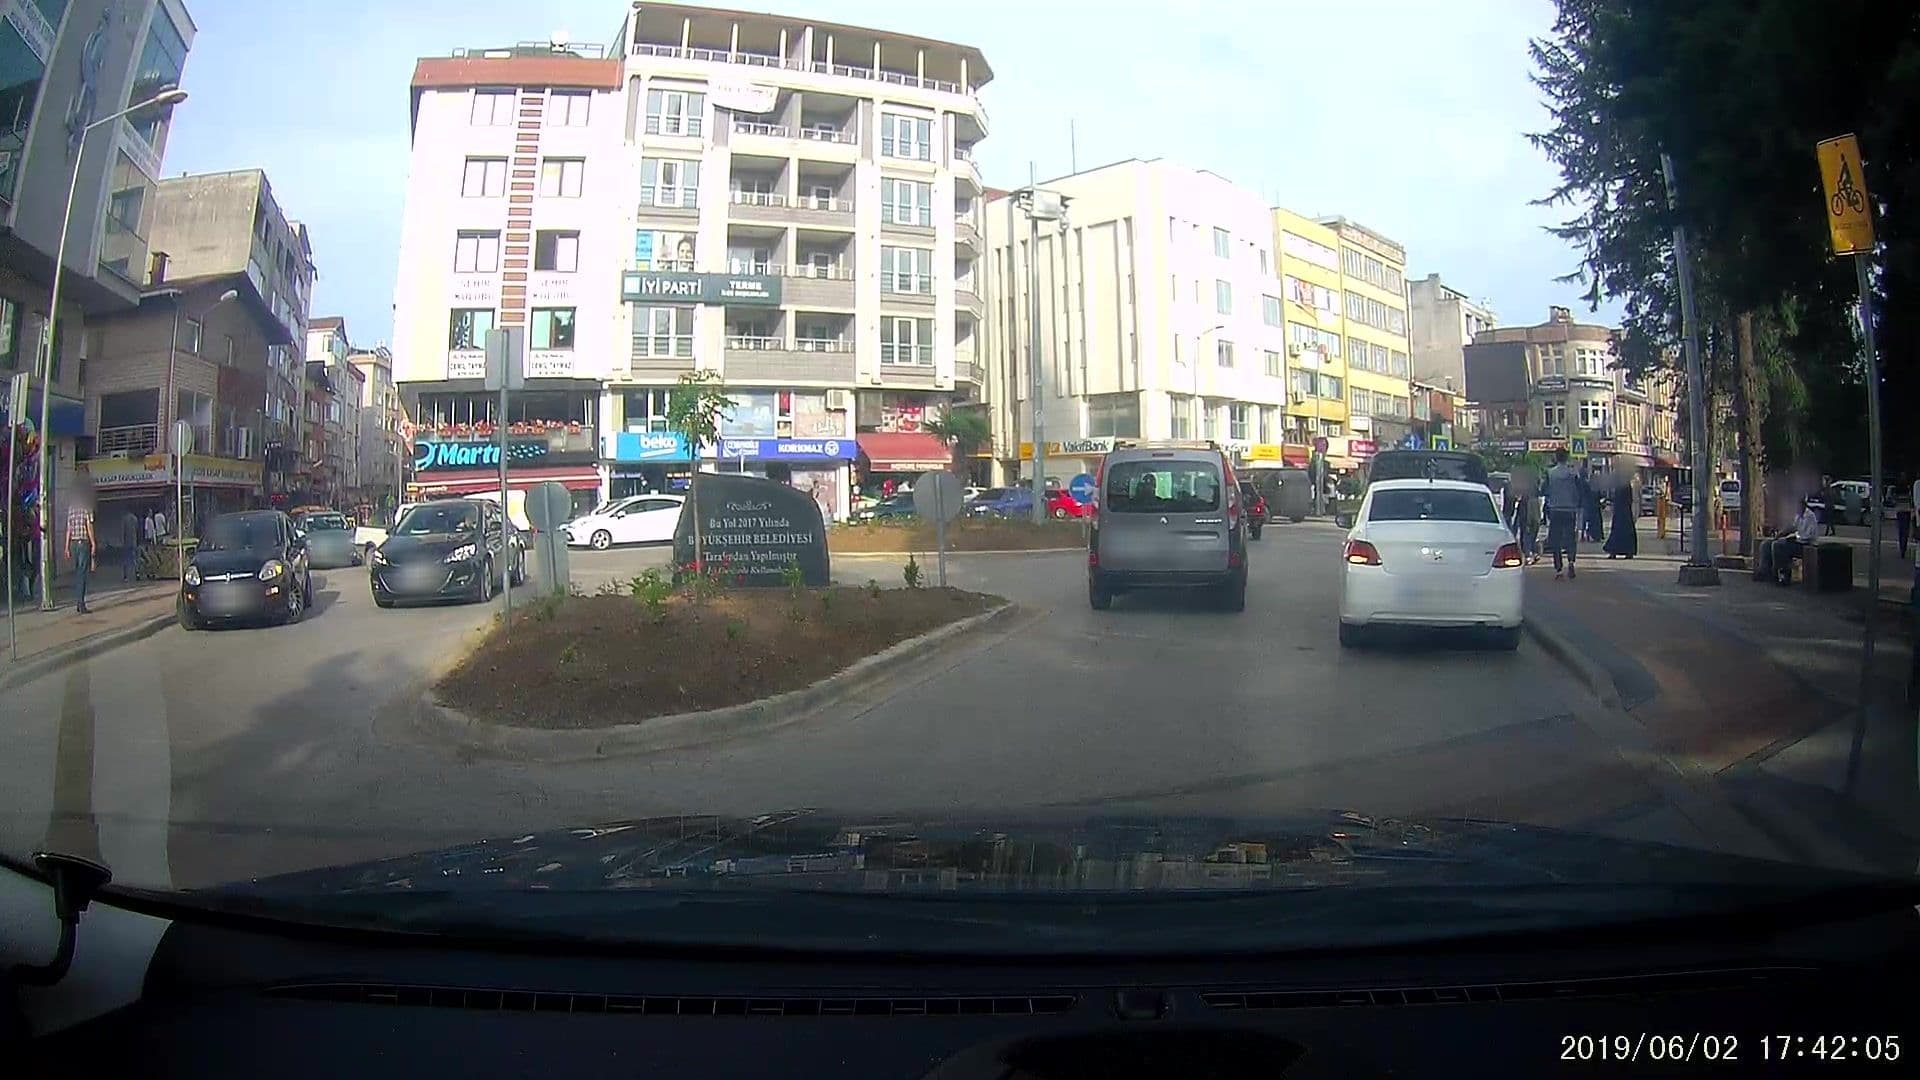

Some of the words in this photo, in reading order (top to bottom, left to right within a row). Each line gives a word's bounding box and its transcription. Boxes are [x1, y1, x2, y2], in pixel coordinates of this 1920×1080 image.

[639, 434, 678, 448] beko
[778, 442, 823, 455] KORKMAZ
[723, 518, 736, 529] Yol
[738, 518, 756, 529] 2017
[759, 517, 790, 529] Yılında
[753, 531, 813, 545] BELEDİYESİ
